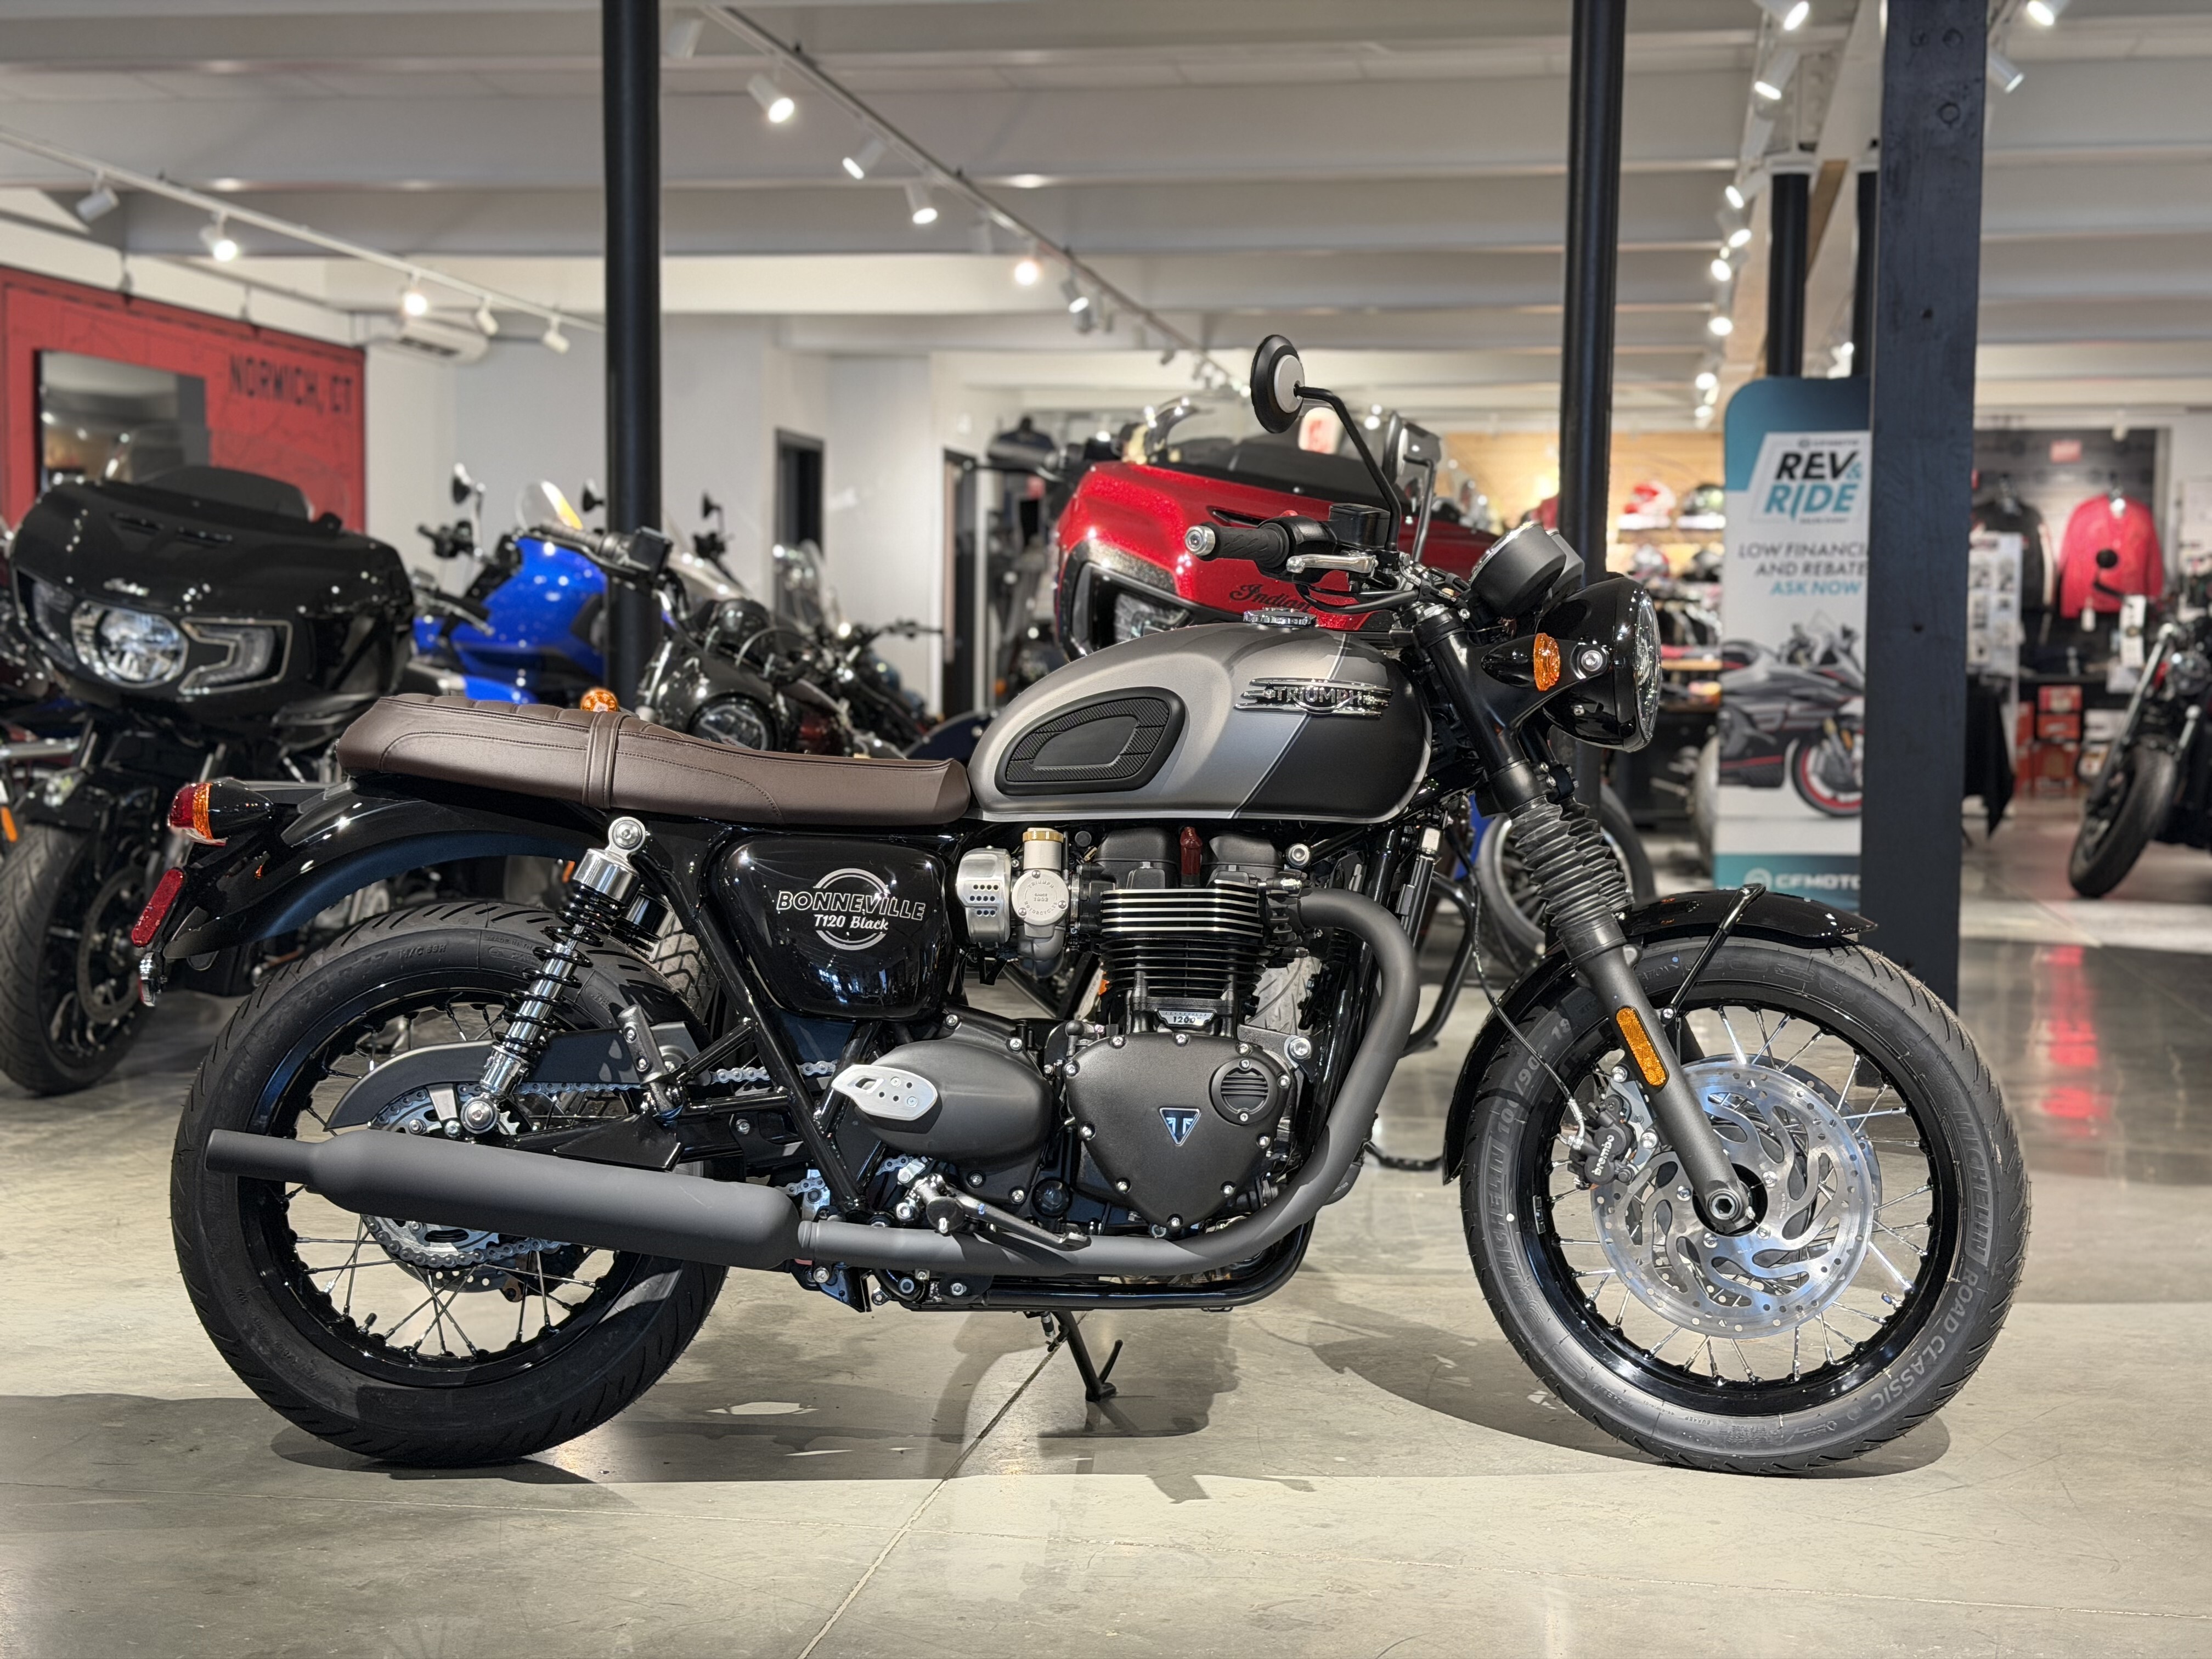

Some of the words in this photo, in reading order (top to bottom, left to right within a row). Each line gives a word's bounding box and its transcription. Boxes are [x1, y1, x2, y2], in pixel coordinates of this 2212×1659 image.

[1775, 451, 1858, 481] REV
[1764, 483, 1859, 520] RIDE
[1739, 542, 1781, 558] LOW
[1784, 542, 1866, 557] FINANCI
[1755, 561, 1798, 576] AND
[1770, 580, 1807, 595] ASK
[1810, 580, 1861, 595] NOW
[1273, 686, 1363, 706] TRIUMPH
[776, 891, 926, 921] BONNEVILLE
[1024, 900, 1058, 916] MOTORCYCLES
[814, 914, 846, 928] T120
[850, 915, 889, 931] Black
[1591, 1134, 1615, 1176] brembo
[1944, 1267, 1979, 1333] ROAD
[1871, 1335, 1946, 1411] CLASSIC
